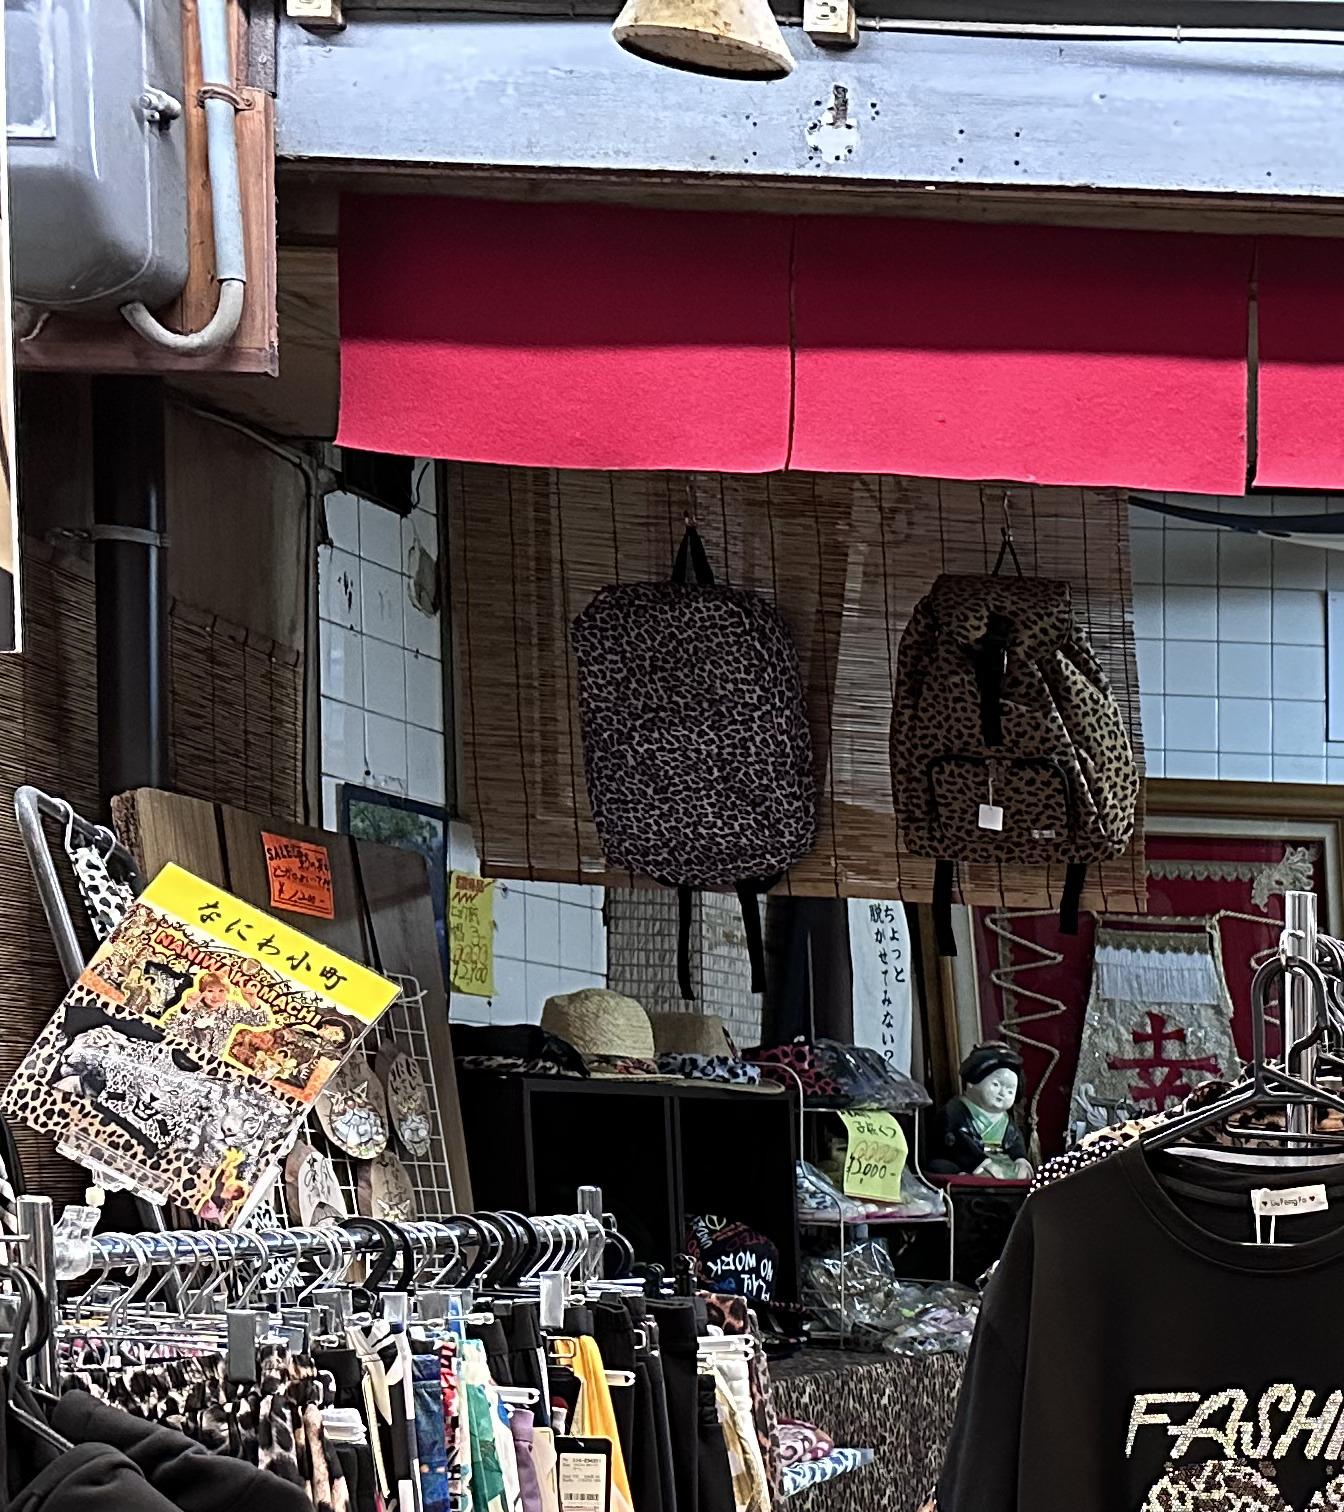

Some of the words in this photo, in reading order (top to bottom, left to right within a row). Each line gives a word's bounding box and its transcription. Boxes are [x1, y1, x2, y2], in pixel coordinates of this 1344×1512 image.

[197, 900, 348, 991] なにわ小町
[229, 968, 323, 1027] KOMACHI
[706, 1250, 757, 1278] WORK
